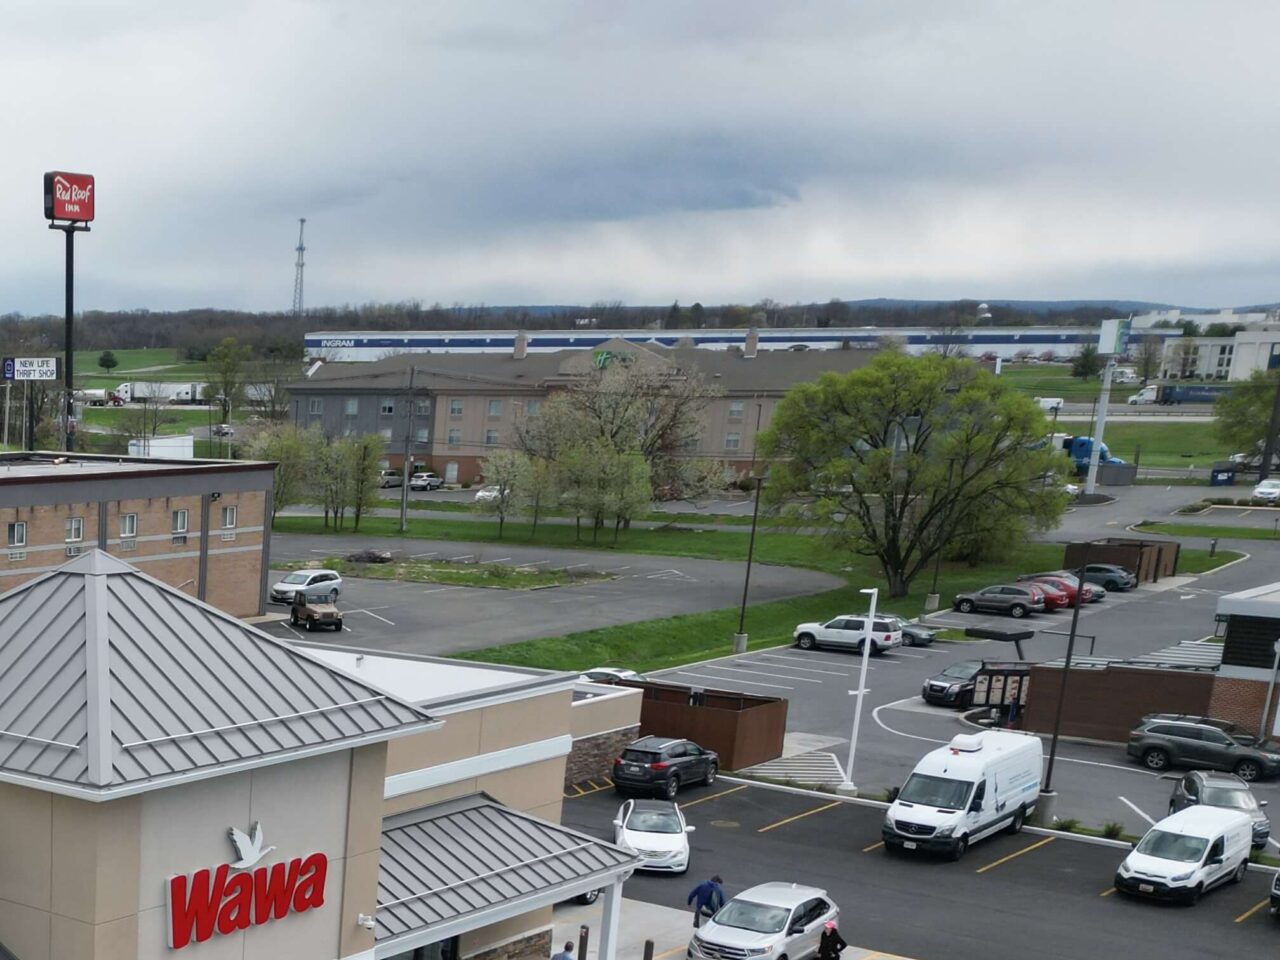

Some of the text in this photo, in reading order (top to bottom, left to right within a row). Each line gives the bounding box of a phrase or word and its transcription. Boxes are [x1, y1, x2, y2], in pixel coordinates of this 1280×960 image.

[56, 183, 92, 203] Red Roof
[20, 360, 51, 368] NEW LIFE
[16, 369, 56, 378] THRIFT SHOP
[168, 852, 328, 950] Wawa
